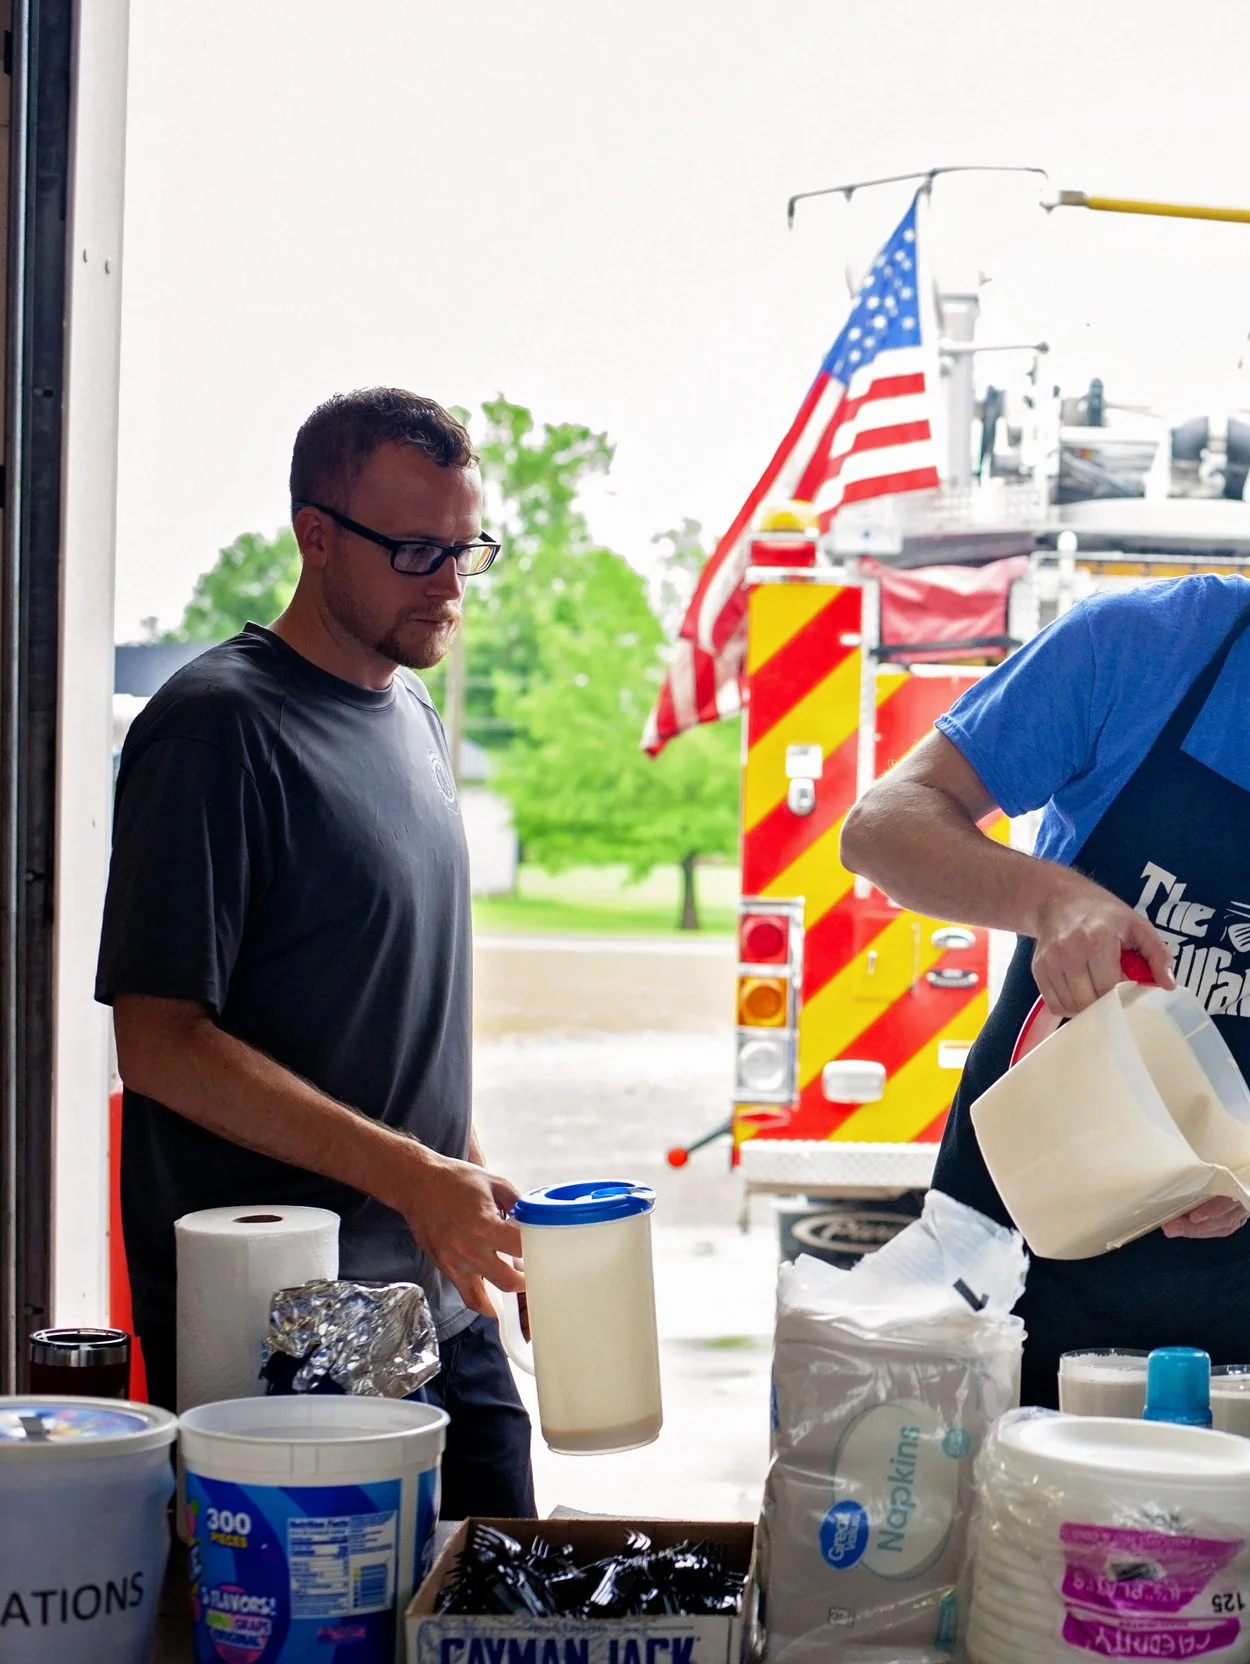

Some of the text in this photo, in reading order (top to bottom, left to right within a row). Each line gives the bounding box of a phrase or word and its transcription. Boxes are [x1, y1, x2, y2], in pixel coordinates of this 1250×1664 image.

[1134, 861, 1217, 938] The
[876, 1425, 921, 1553] Napkins
[206, 1507, 252, 1535] 300
[828, 1513, 850, 1560] Great
[211, 1531, 249, 1549] PIECES
[0, 1570, 144, 1628] ATIONS
[1211, 1592, 1246, 1613] 125
[439, 1636, 696, 1664] CAYMAN JACK
